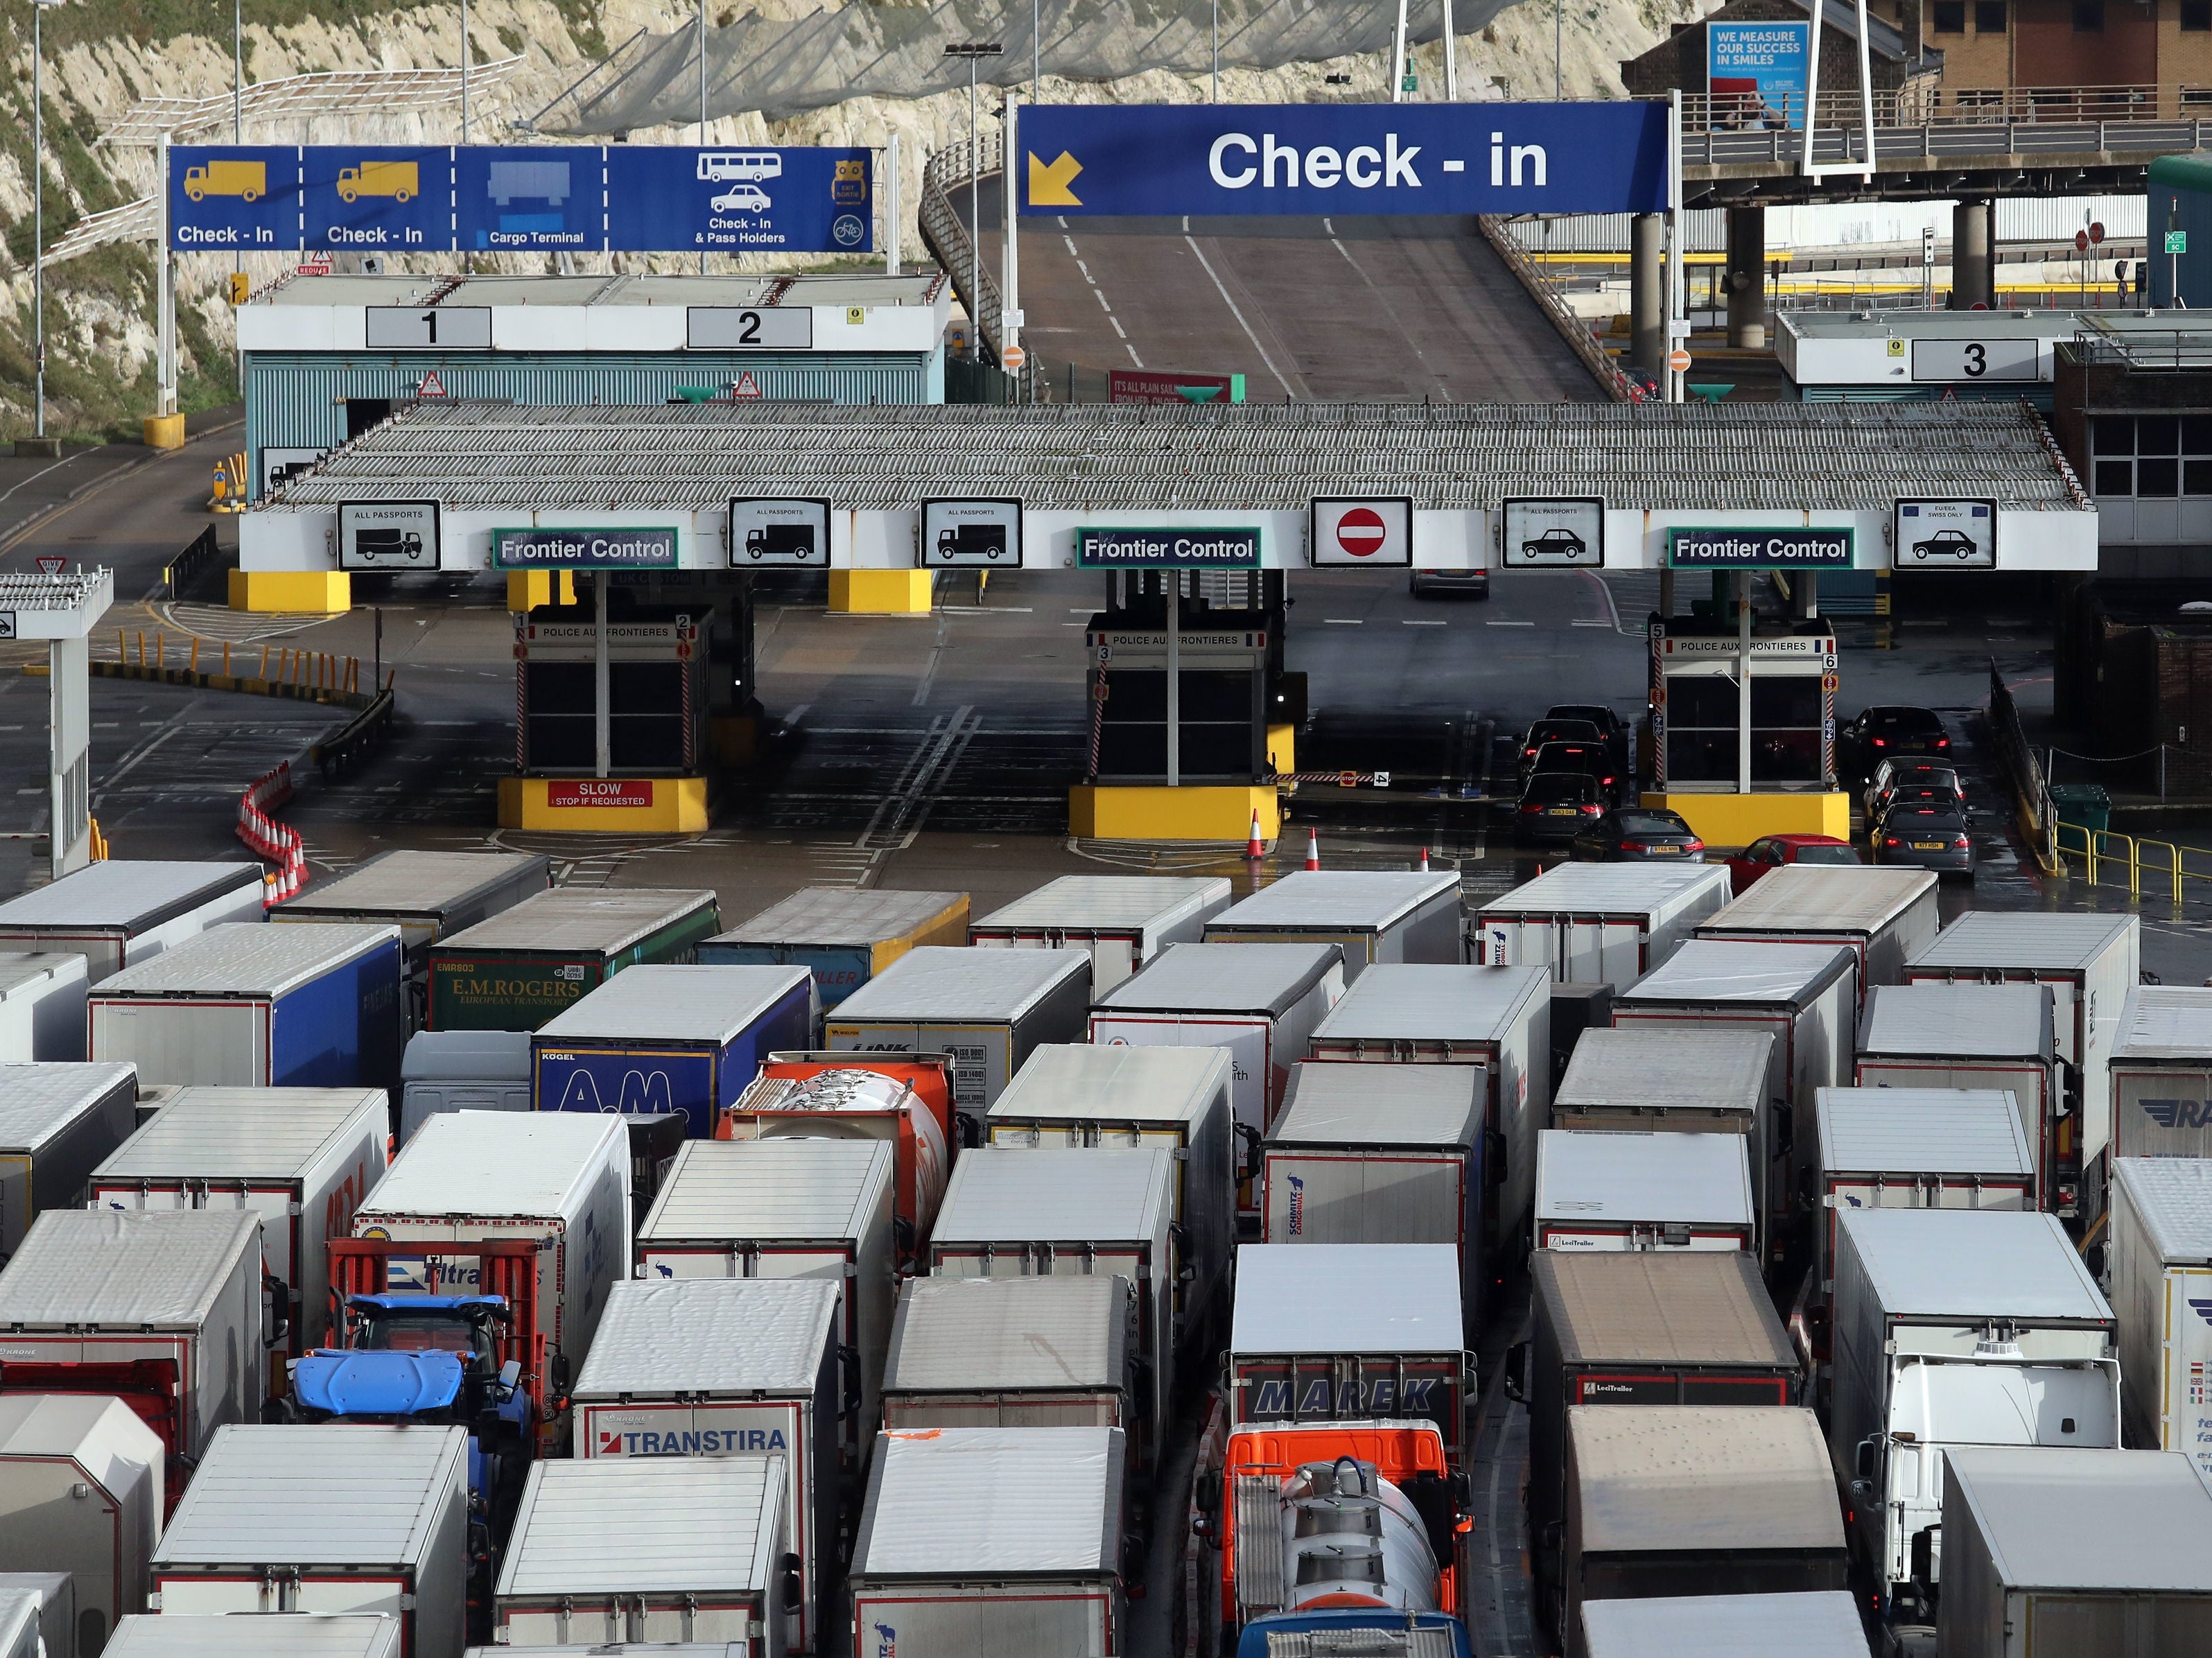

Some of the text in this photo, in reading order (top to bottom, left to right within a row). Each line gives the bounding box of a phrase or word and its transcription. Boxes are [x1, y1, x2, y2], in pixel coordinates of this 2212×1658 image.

[1717, 31, 1796, 42] WE MEASURE
[1717, 43, 1800, 53] OUR SUCCESS
[1717, 55, 1775, 65] IN SMILES
[1208, 131, 1547, 189] Check - in
[708, 218, 747, 231] Check
[759, 218, 772, 230] In
[177, 226, 238, 243] Check
[256, 226, 273, 243] In
[327, 227, 388, 243] Check
[406, 227, 423, 243] In
[489, 232, 584, 245] Cargo Terminal
[695, 232, 785, 244] & Pass Holders
[421, 311, 437, 344] 1
[738, 311, 762, 344] 2
[1964, 343, 1987, 377] 3
[1114, 381, 1126, 391] IT'S
[1127, 381, 1140, 392] ALL
[1140, 382, 1160, 394] PLAIN
[1115, 394, 1133, 404] FROM
[354, 511, 424, 519] ALL PASSPORTS
[500, 538, 670, 559] Frontier Control
[1084, 539, 1253, 558] Frontier Control
[1676, 538, 1846, 558] Frontier Control
[518, 615, 523, 627] 1
[679, 616, 688, 628] 2
[543, 628, 669, 638] POLICE AU FRONTIERES
[1653, 625, 1662, 637] 5
[1113, 636, 1149, 645] POLICE
[1681, 642, 1806, 651] POLICE AUX RONTIERES
[1100, 647, 1108, 659] 3
[1826, 655, 1836, 667] 6
[1375, 774, 1387, 783] 4
[579, 783, 622, 795] SLOW
[591, 797, 645, 805] REQUESTED
[437, 963, 474, 972] EMR803
[453, 979, 581, 998] E.M.ROGERS
[460, 996, 570, 1006] EUROPEAN TRANSPORT
[541, 1052, 575, 1061] KÖGEL
[959, 1048, 984, 1056] ISO 9001
[1289, 1191, 1298, 1236] SCHMITZ
[1596, 1384, 1633, 1393] LeciTrailer
[1253, 1378, 1438, 1414] MAREK
[623, 1429, 787, 1454] TRANSTIRA
